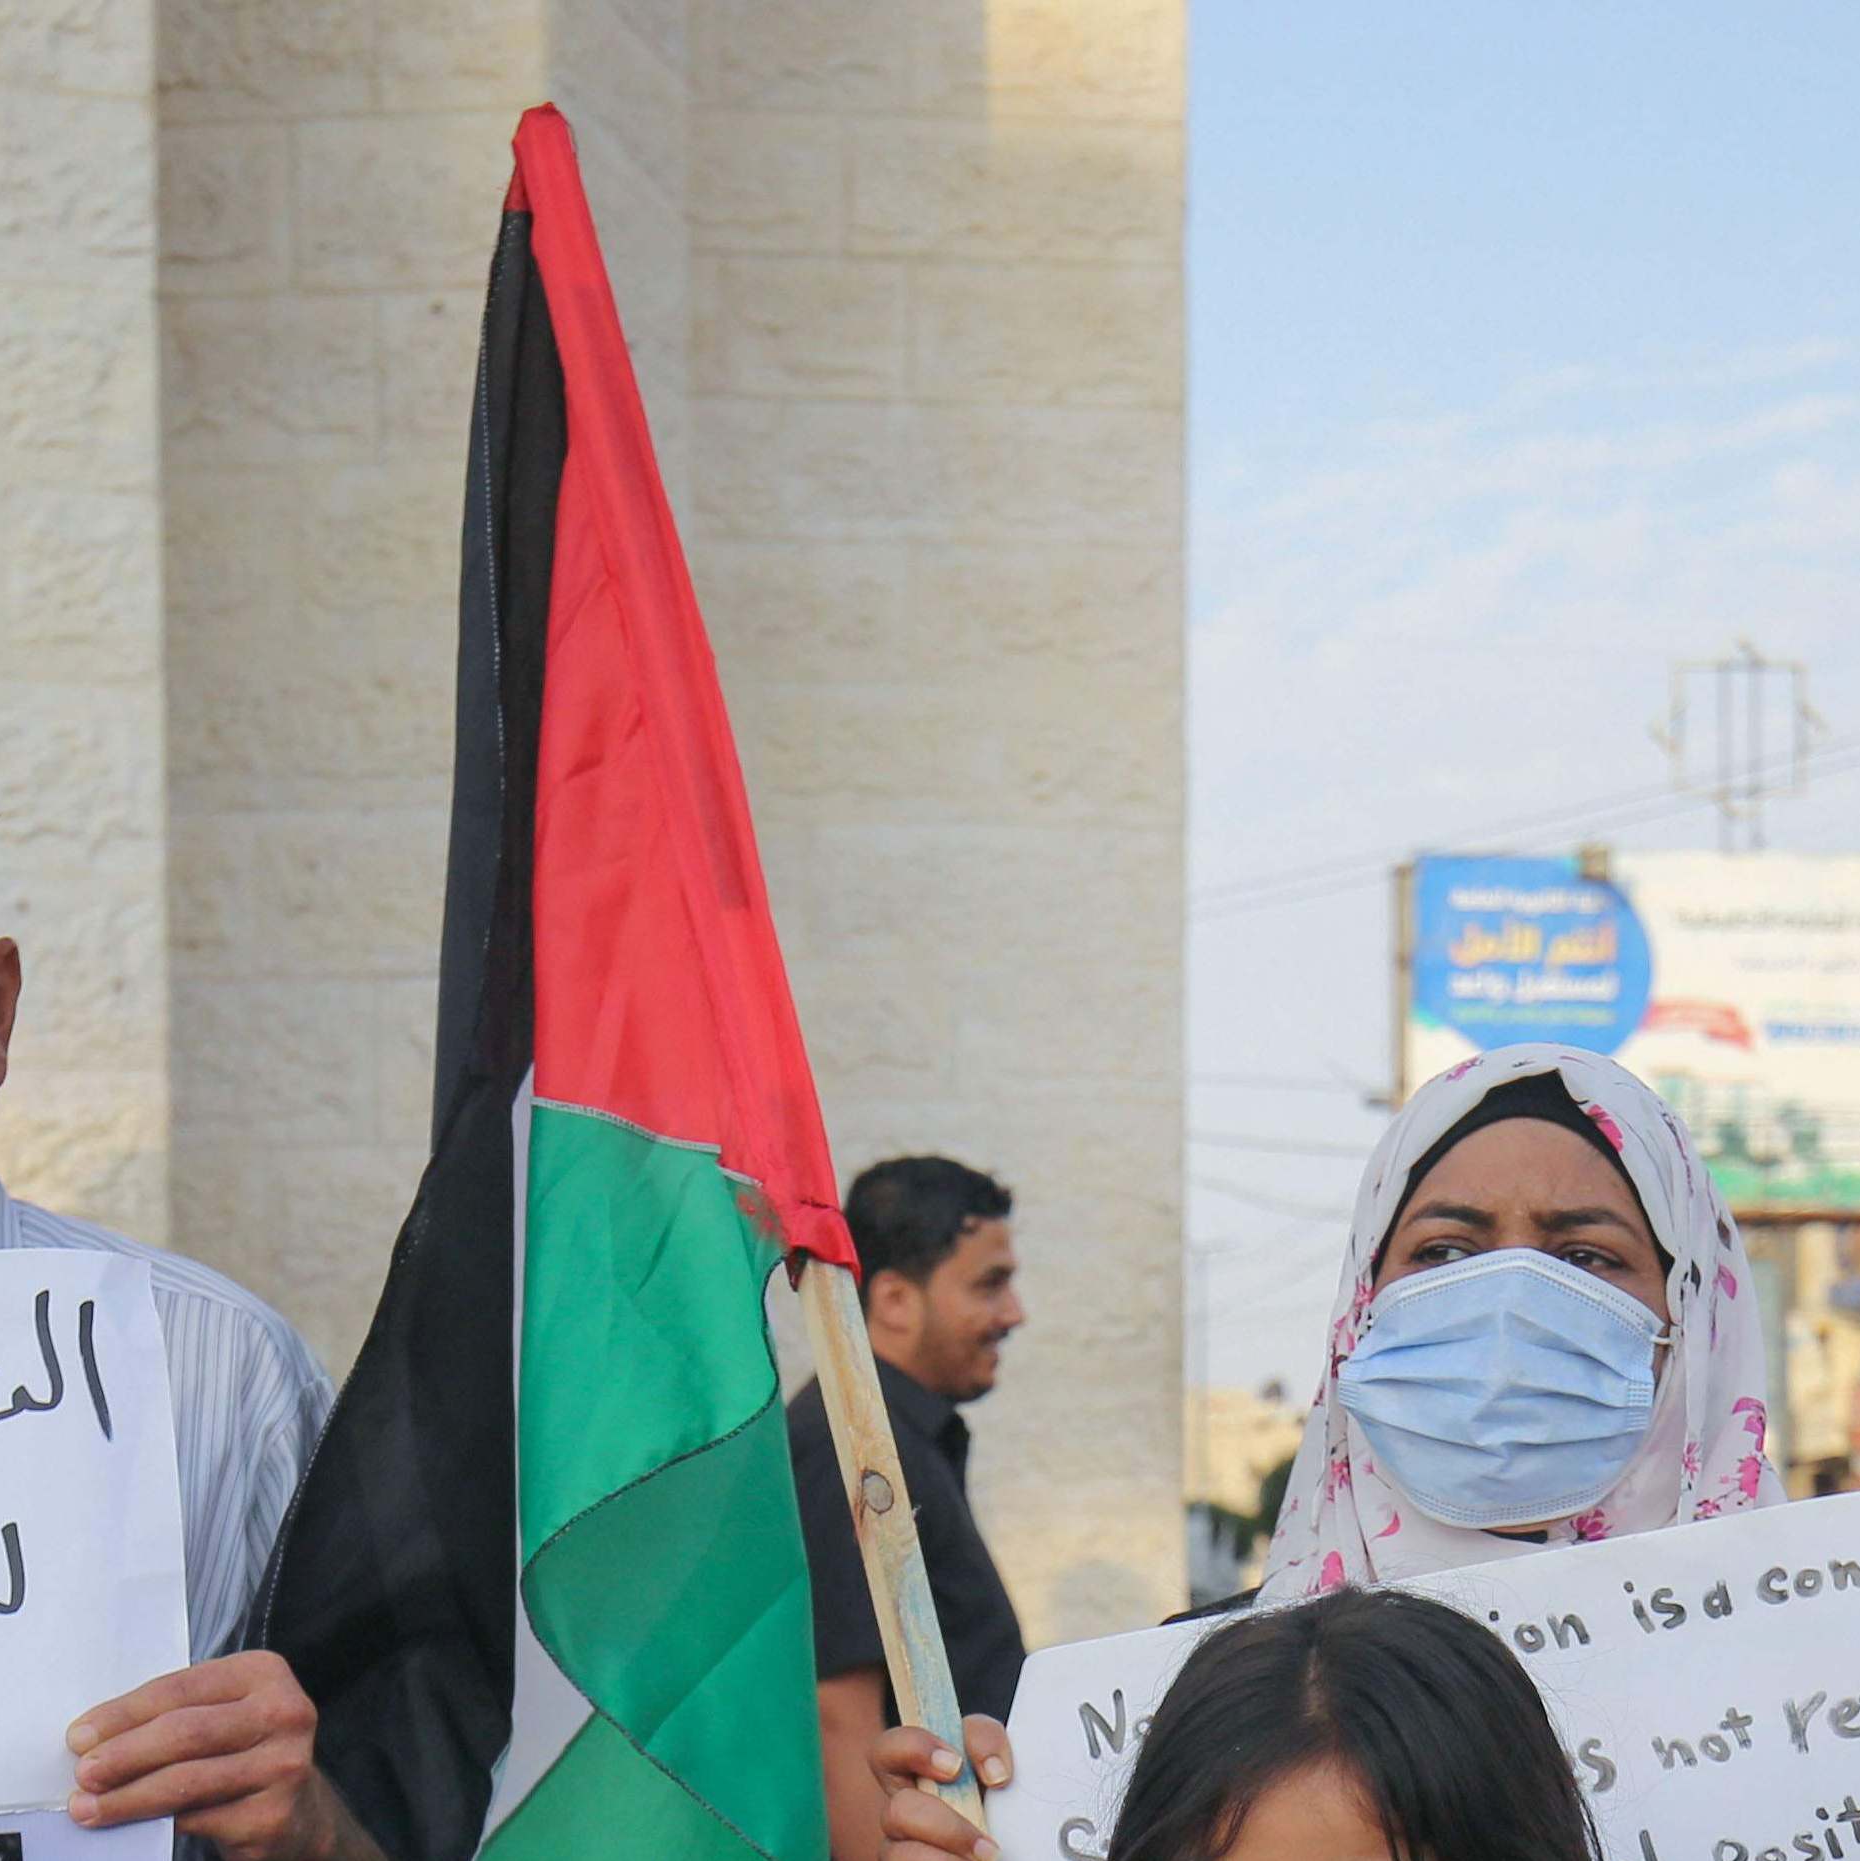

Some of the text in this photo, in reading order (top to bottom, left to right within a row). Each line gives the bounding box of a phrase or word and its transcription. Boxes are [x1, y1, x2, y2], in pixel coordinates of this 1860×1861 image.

[1624, 1582, 1687, 1633] is
[1703, 1581, 1733, 1619] a
[1652, 1708, 1752, 1769] not
